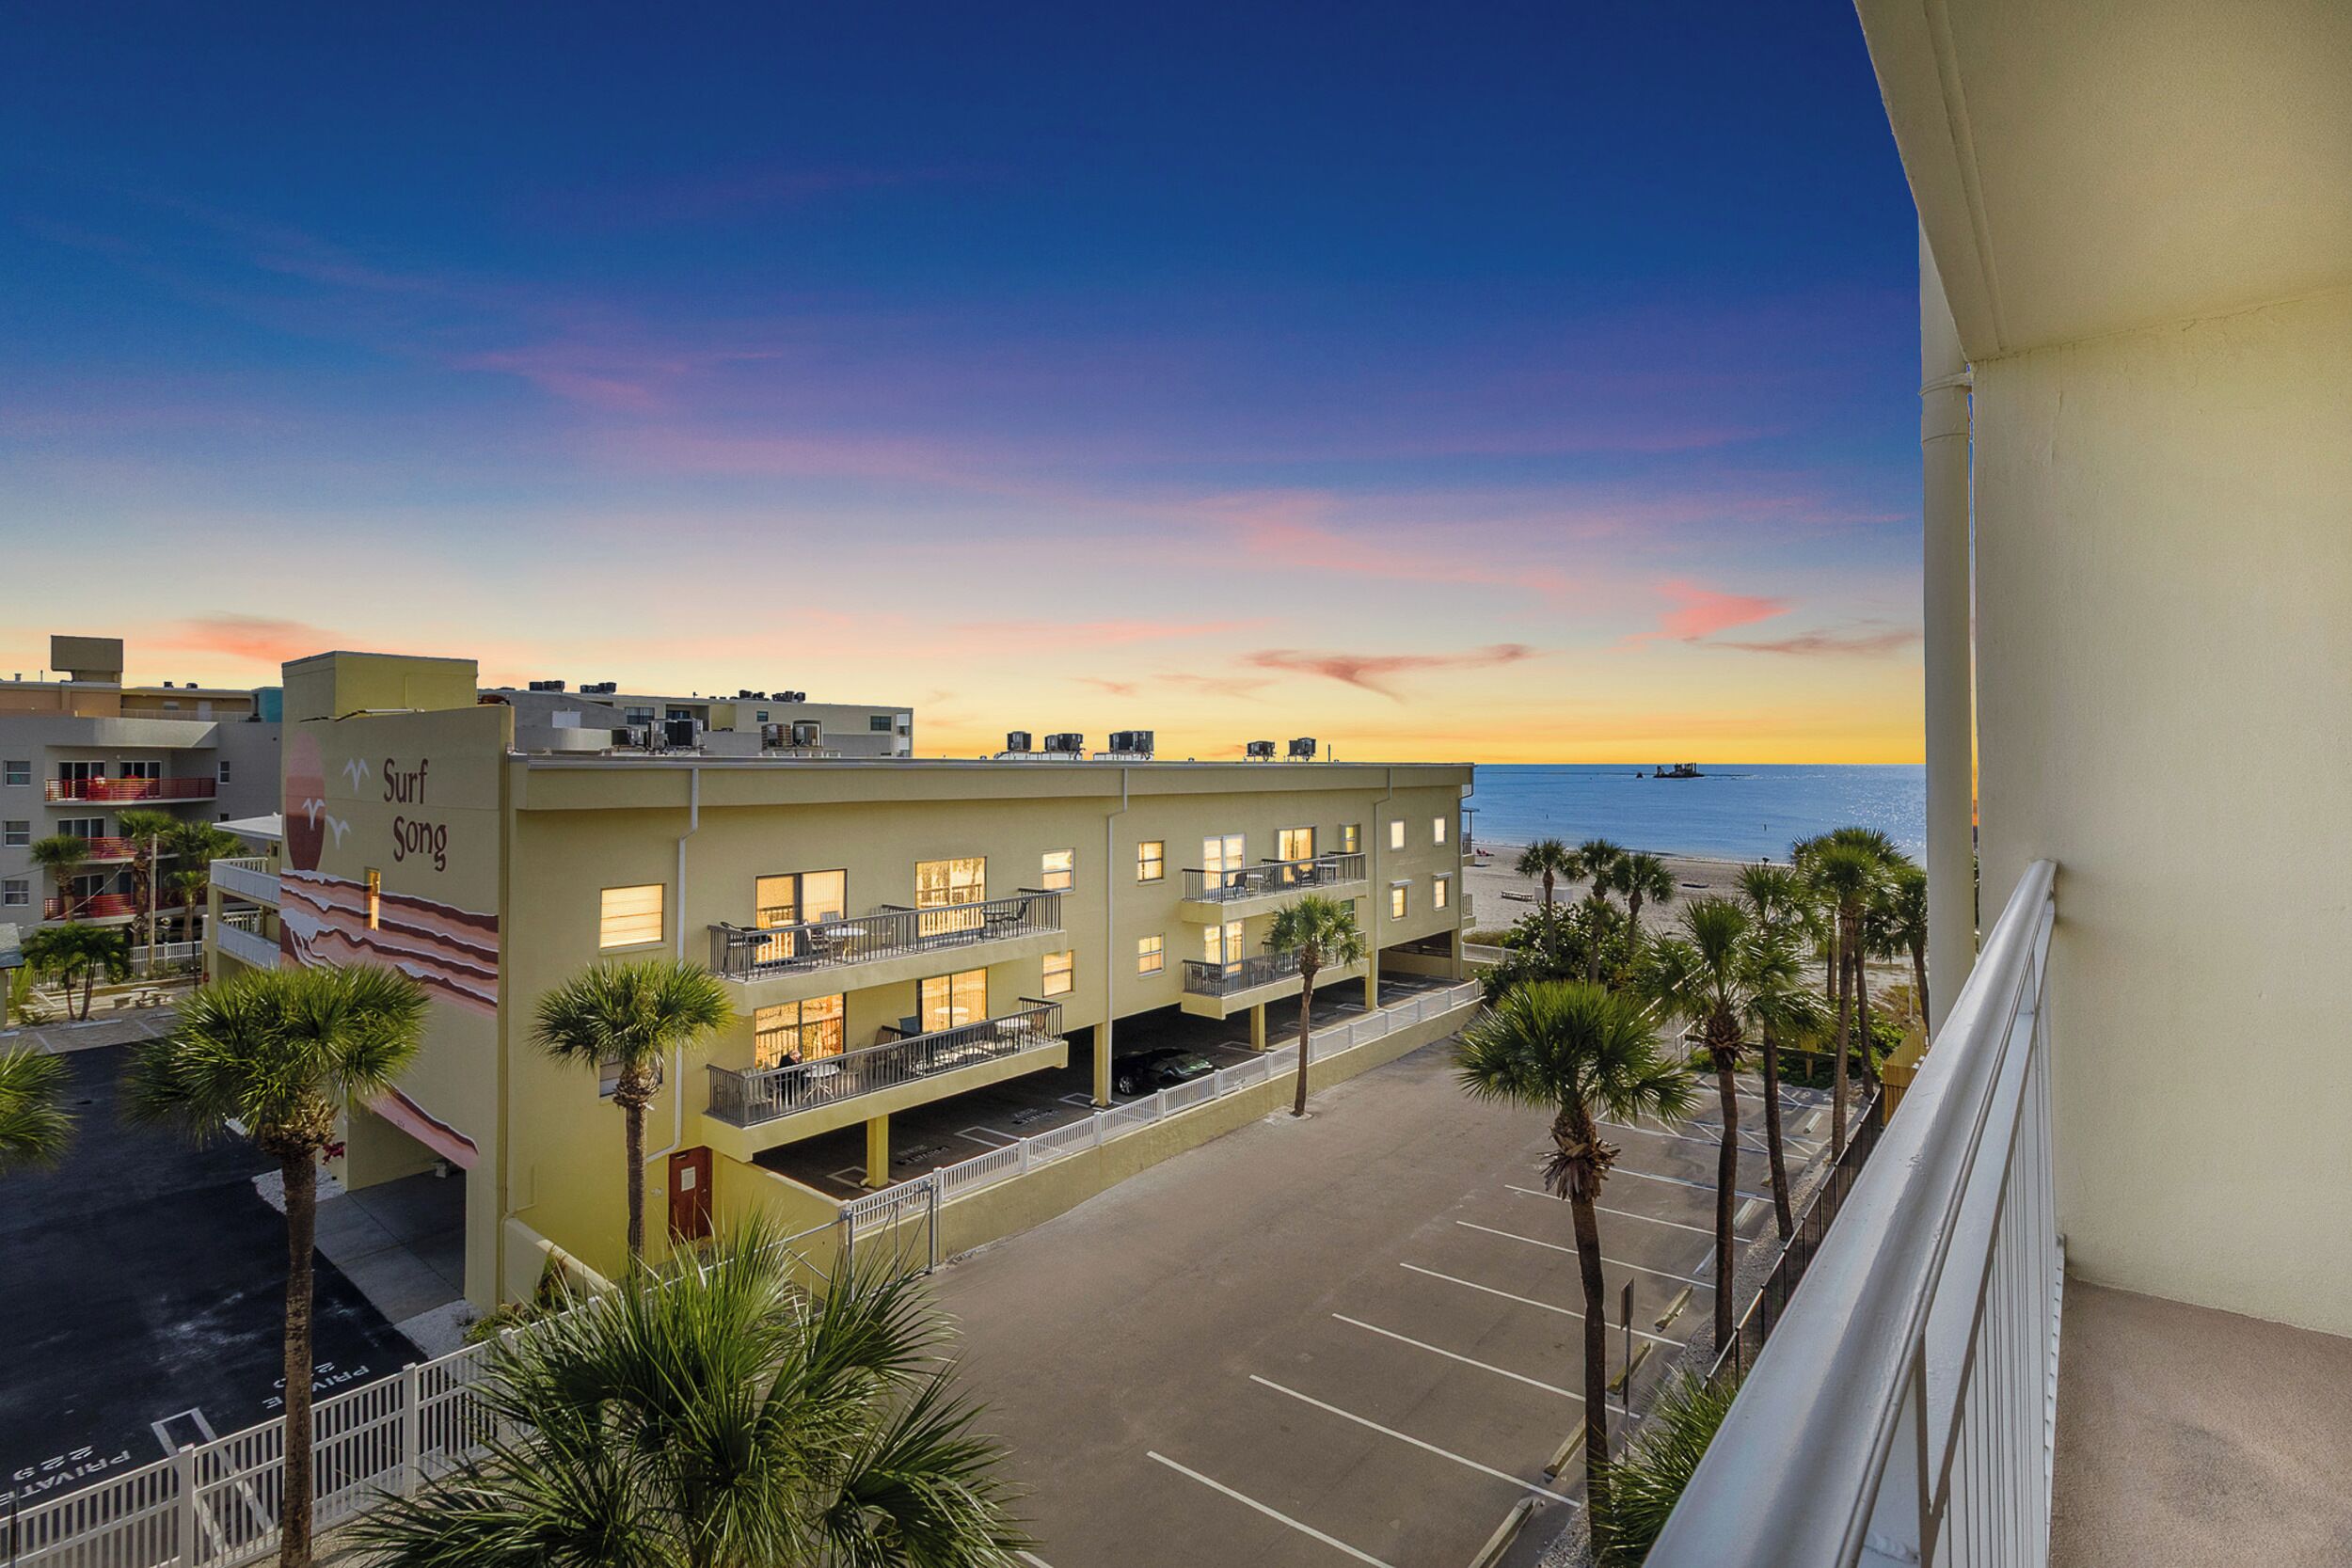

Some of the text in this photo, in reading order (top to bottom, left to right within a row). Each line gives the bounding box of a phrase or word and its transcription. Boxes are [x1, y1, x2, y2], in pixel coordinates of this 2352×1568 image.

[383, 758, 429, 804] Surf
[392, 816, 447, 872] Song
[262, 1365, 370, 1409] PRIVE
[13, 1445, 93, 1481] 229
